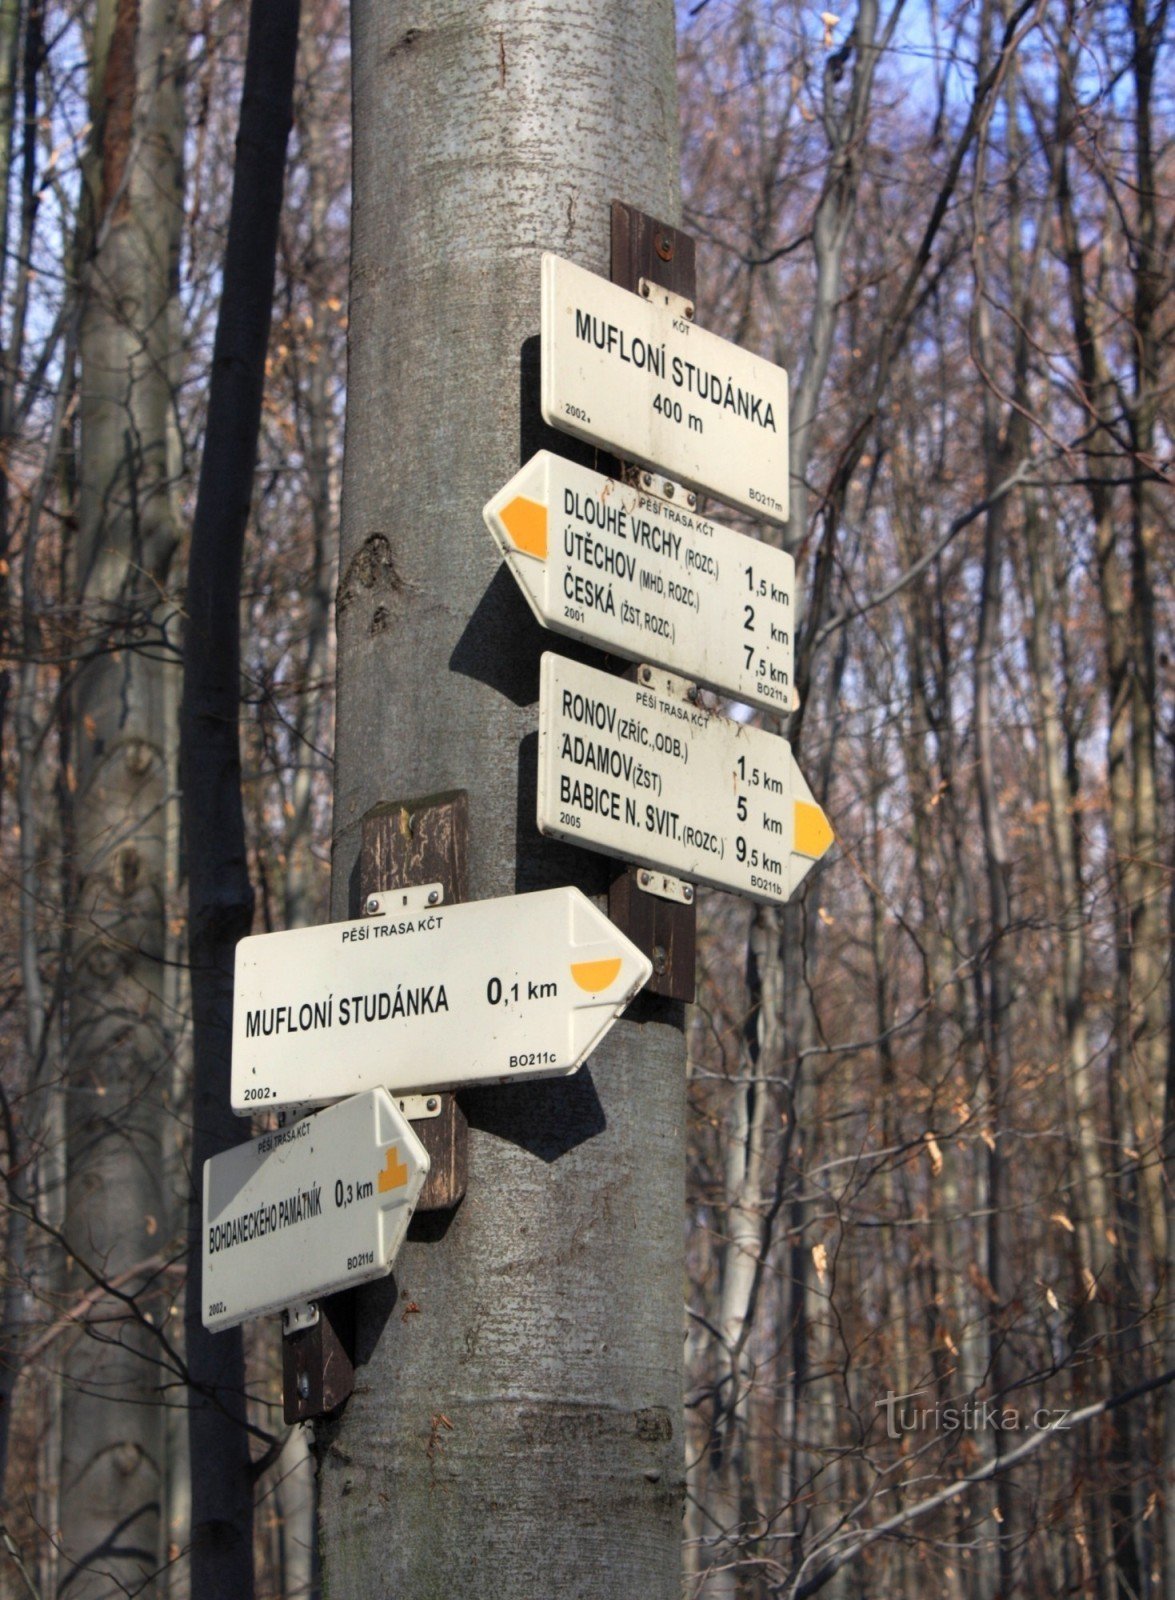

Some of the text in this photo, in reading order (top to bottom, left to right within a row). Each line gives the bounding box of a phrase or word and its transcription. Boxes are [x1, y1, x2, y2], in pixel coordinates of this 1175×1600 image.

[576, 309, 776, 433] MUFLONÍ STUDÁNKA
[653, 393, 703, 434] 400 m
[749, 488, 783, 512] BO217m
[663, 507, 693, 530] TRASA
[696, 520, 714, 537] KČT
[564, 488, 627, 539] DLOUHÉ
[631, 517, 682, 561] VRCHY
[771, 583, 790, 606] km
[564, 525, 636, 581] ÚTĚCHOV
[743, 605, 755, 632] 2
[770, 623, 789, 645] km
[563, 565, 615, 617] ČESKÁ
[770, 662, 788, 686] km
[564, 606, 585, 623] 2001
[757, 683, 788, 704] BO211a
[659, 701, 690, 722] TRASA
[562, 690, 616, 733] RONOV
[764, 773, 783, 795] km
[561, 733, 633, 782] ADAMOV
[736, 796, 747, 822] 5
[763, 813, 783, 835] km
[560, 812, 581, 829] 2005
[560, 775, 620, 821] BABICE
[626, 797, 641, 827] N.
[645, 805, 681, 841] SVIT.
[762, 853, 782, 876] km
[751, 876, 782, 895] BO211b
[342, 917, 443, 944] PĚŠÍ TRASA KČT
[246, 976, 558, 1039] MUFLONÍ STUDÁNKA 0,1 km
[509, 1052, 557, 1068] BO211c
[274, 1130, 296, 1148] TRASA
[209, 1203, 277, 1255] BOHDANECKÉHO
[279, 1181, 322, 1231] PAMÁTNÍK
[356, 1181, 373, 1201] km
[347, 1251, 374, 1271] BO211d
